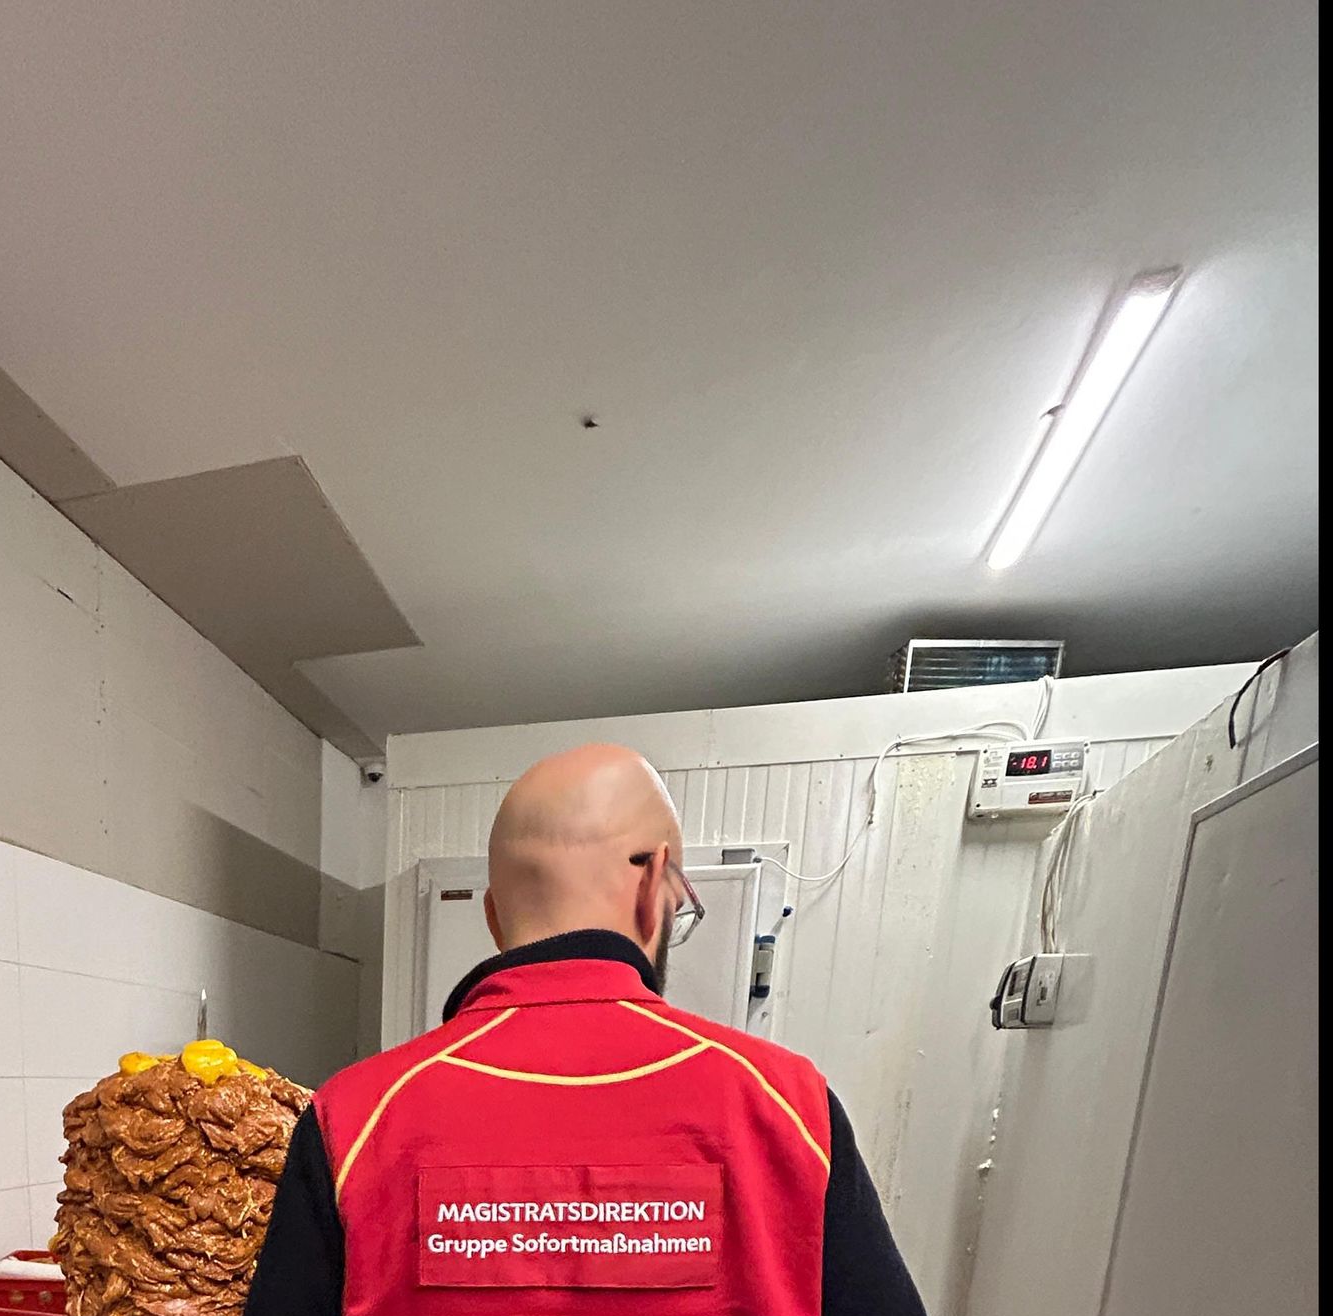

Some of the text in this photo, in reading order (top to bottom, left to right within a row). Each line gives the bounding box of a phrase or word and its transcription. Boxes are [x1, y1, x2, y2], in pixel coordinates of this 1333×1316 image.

[1012, 755, 1048, 769] -18.1
[437, 1201, 705, 1222] MAGISTRATSDIREKTION
[427, 1232, 712, 1259] Gruppe Sofortmaßnahmen
